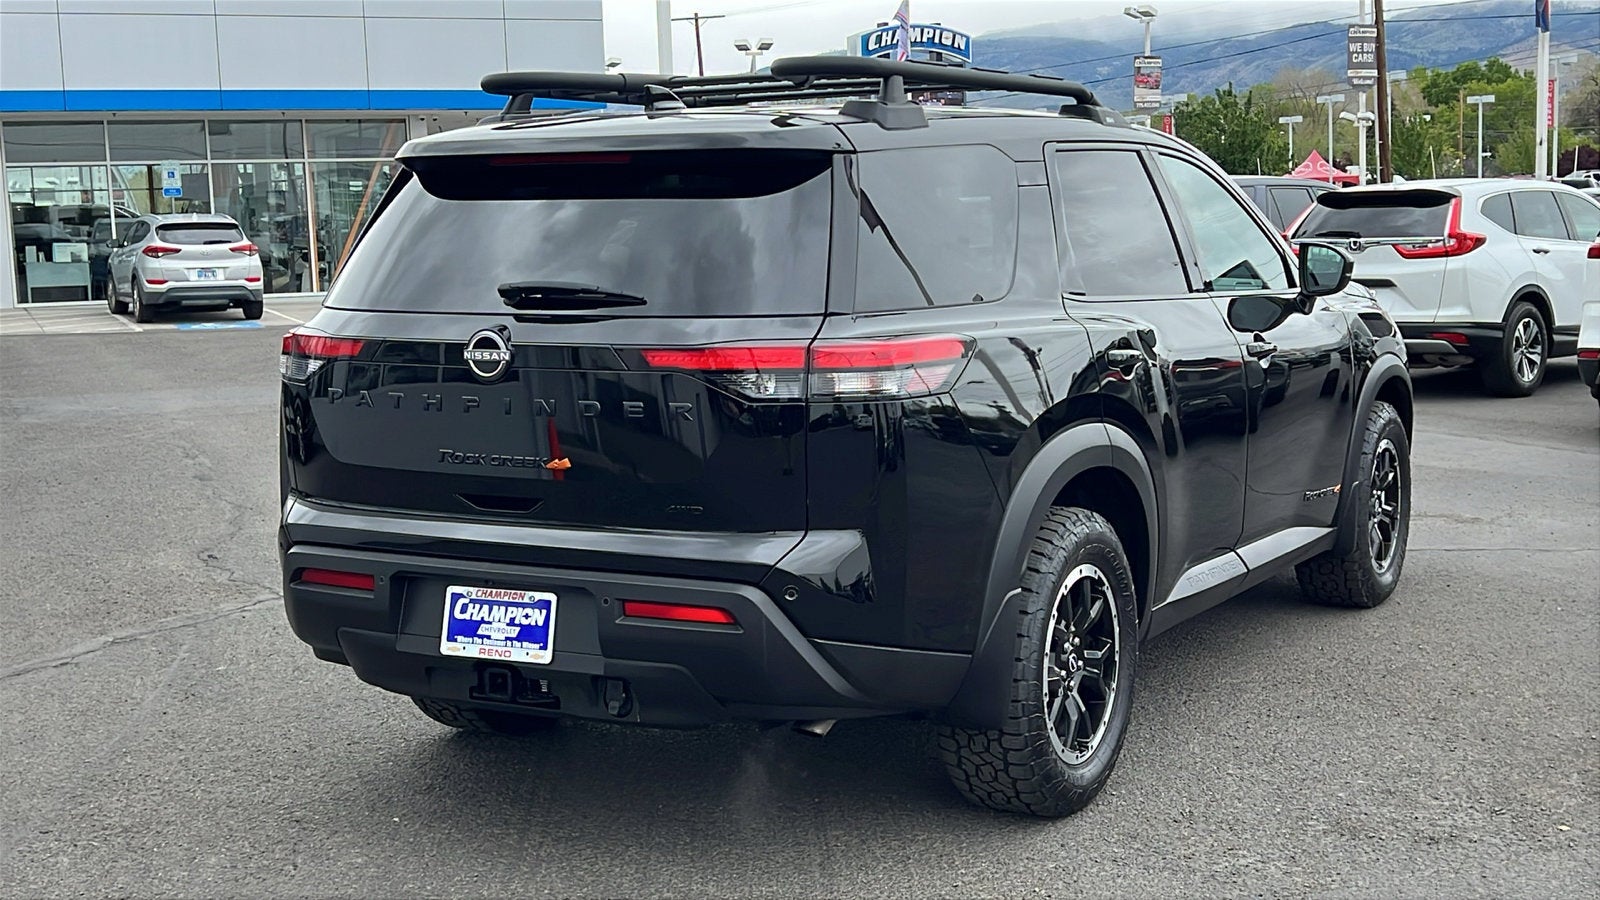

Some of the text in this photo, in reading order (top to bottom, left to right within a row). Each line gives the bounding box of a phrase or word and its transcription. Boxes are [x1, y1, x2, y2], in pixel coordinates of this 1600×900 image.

[868, 27, 967, 51] CHAMPION
[1349, 43, 1376, 52] WE BUY
[1352, 53, 1374, 62] CARS!
[464, 351, 510, 361] NISSAN
[328, 387, 694, 421] PATHFINDER
[475, 589, 527, 601] CHAMPION
[454, 598, 547, 626] CHAMPION
[480, 626, 517, 636] CHEVROLET
[479, 648, 512, 659] RENO
